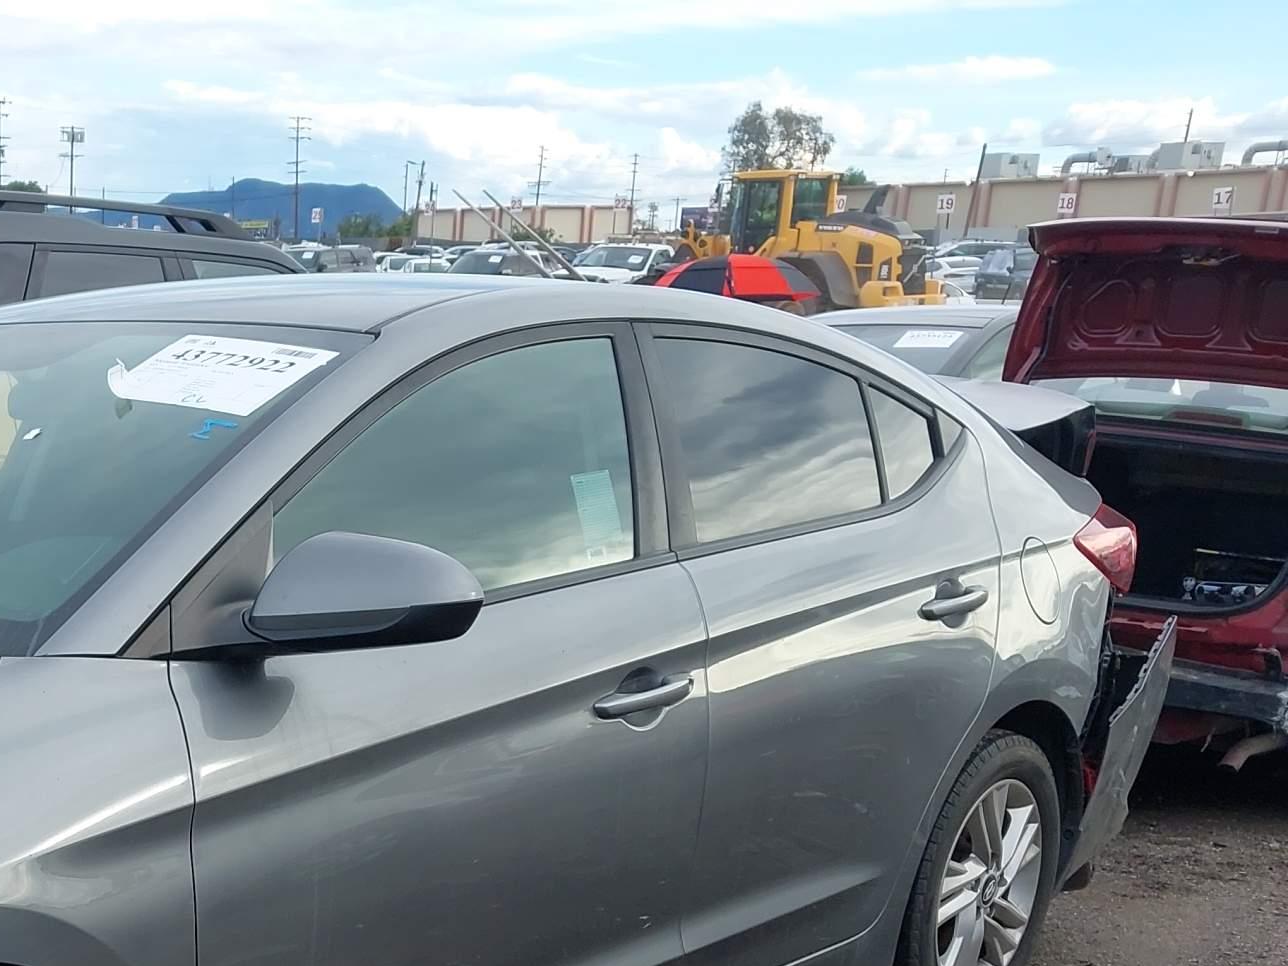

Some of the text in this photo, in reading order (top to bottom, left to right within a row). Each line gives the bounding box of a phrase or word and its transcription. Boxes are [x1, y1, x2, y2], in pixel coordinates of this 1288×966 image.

[511, 199, 522, 209] 23
[614, 199, 627, 209] 22
[1059, 197, 1074, 210] 18
[1214, 191, 1233, 206] 17
[938, 199, 954, 211] 19
[172, 348, 297, 373] 43772922
